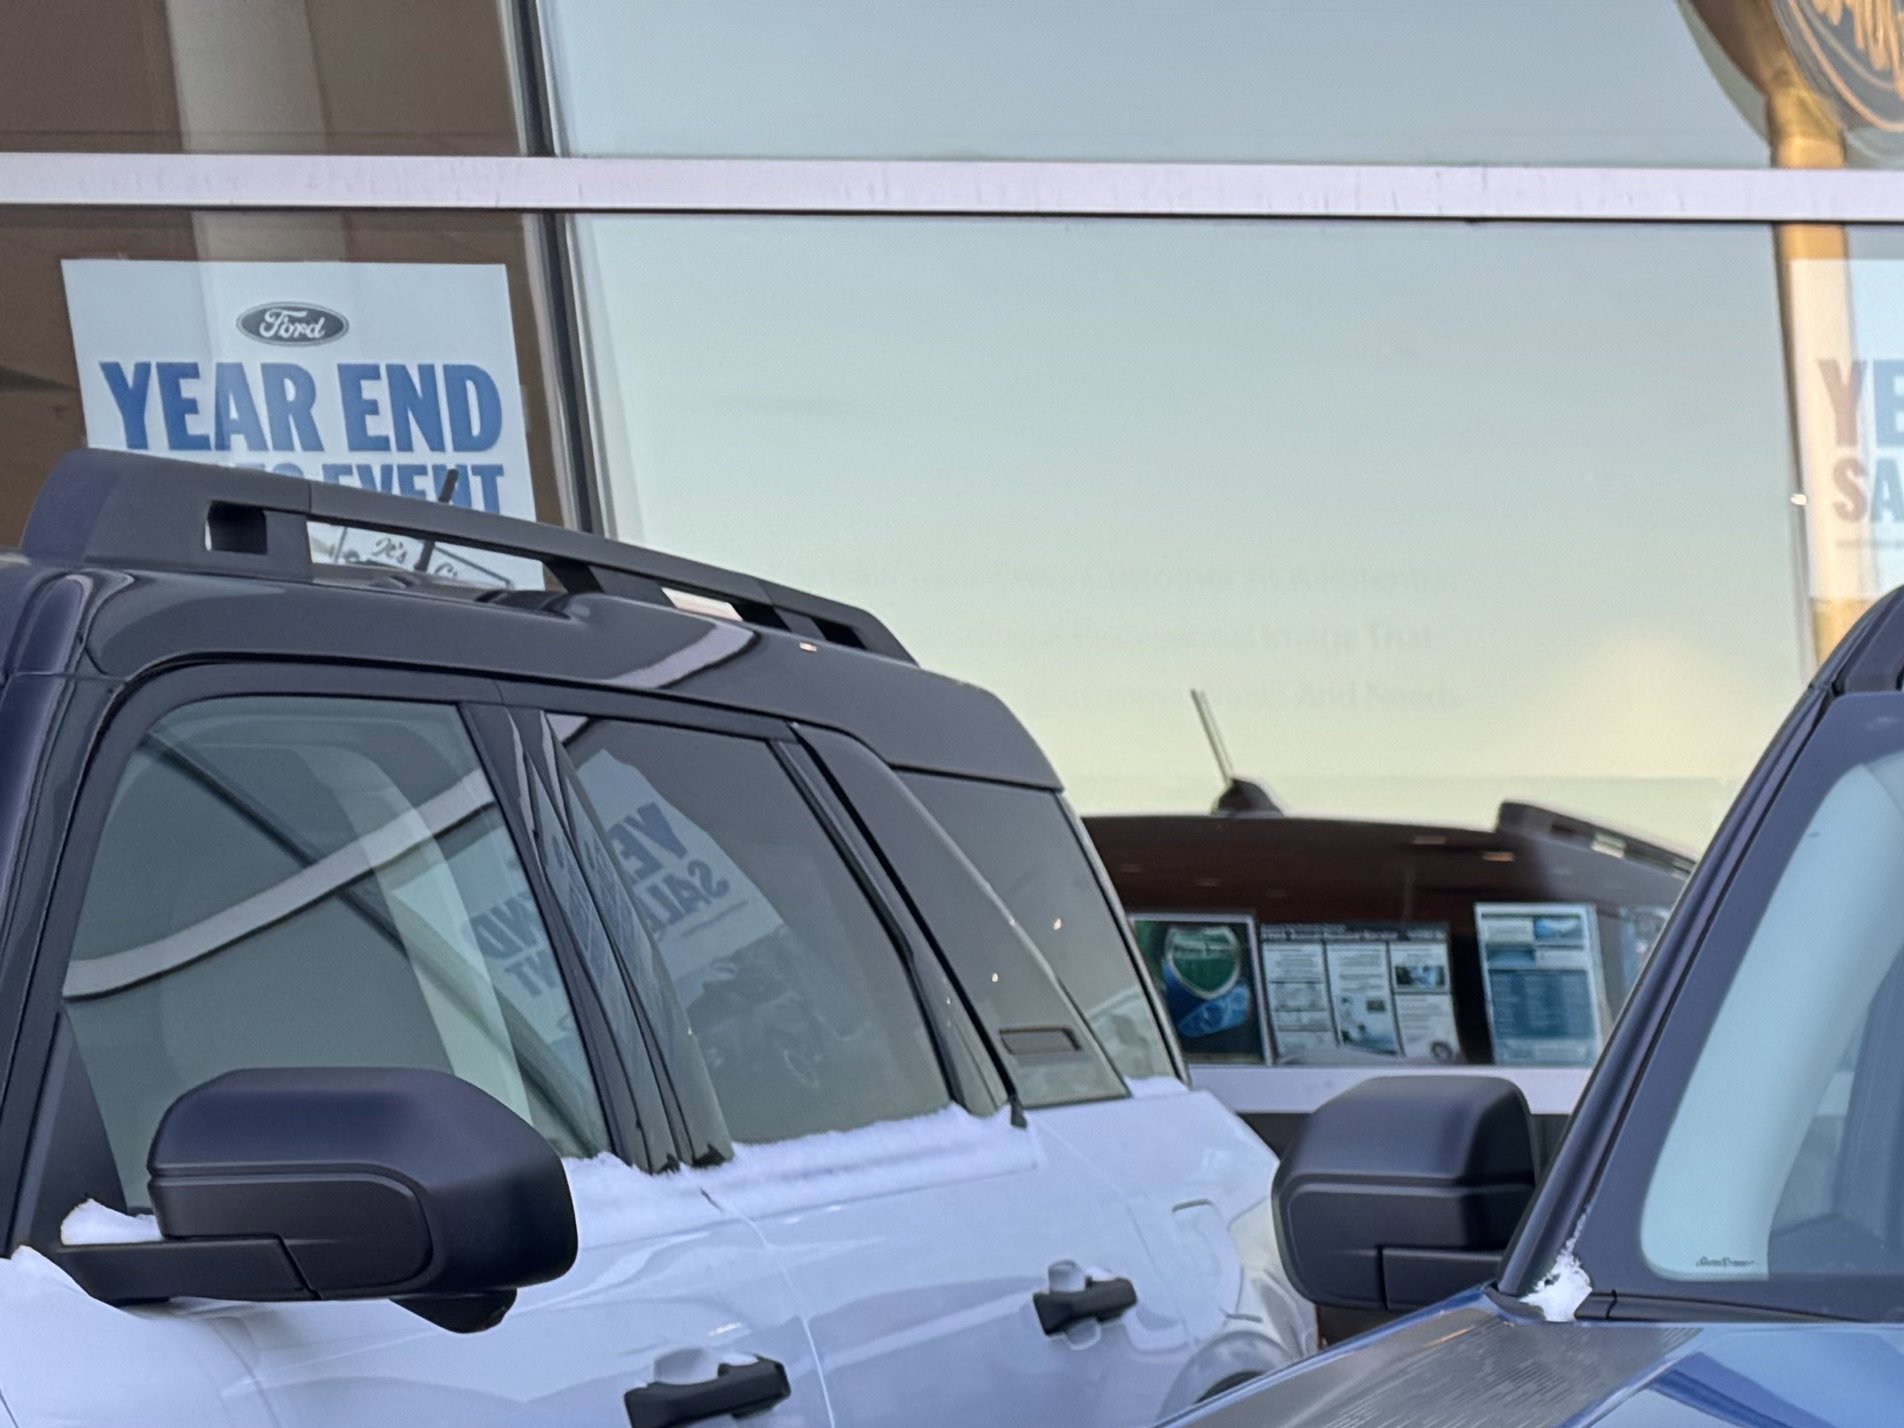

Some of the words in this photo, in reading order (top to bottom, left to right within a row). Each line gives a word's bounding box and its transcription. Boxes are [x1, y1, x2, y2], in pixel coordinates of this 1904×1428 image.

[259, 307, 326, 341] Ford
[100, 361, 324, 452] YEAR
[337, 363, 502, 452] END
